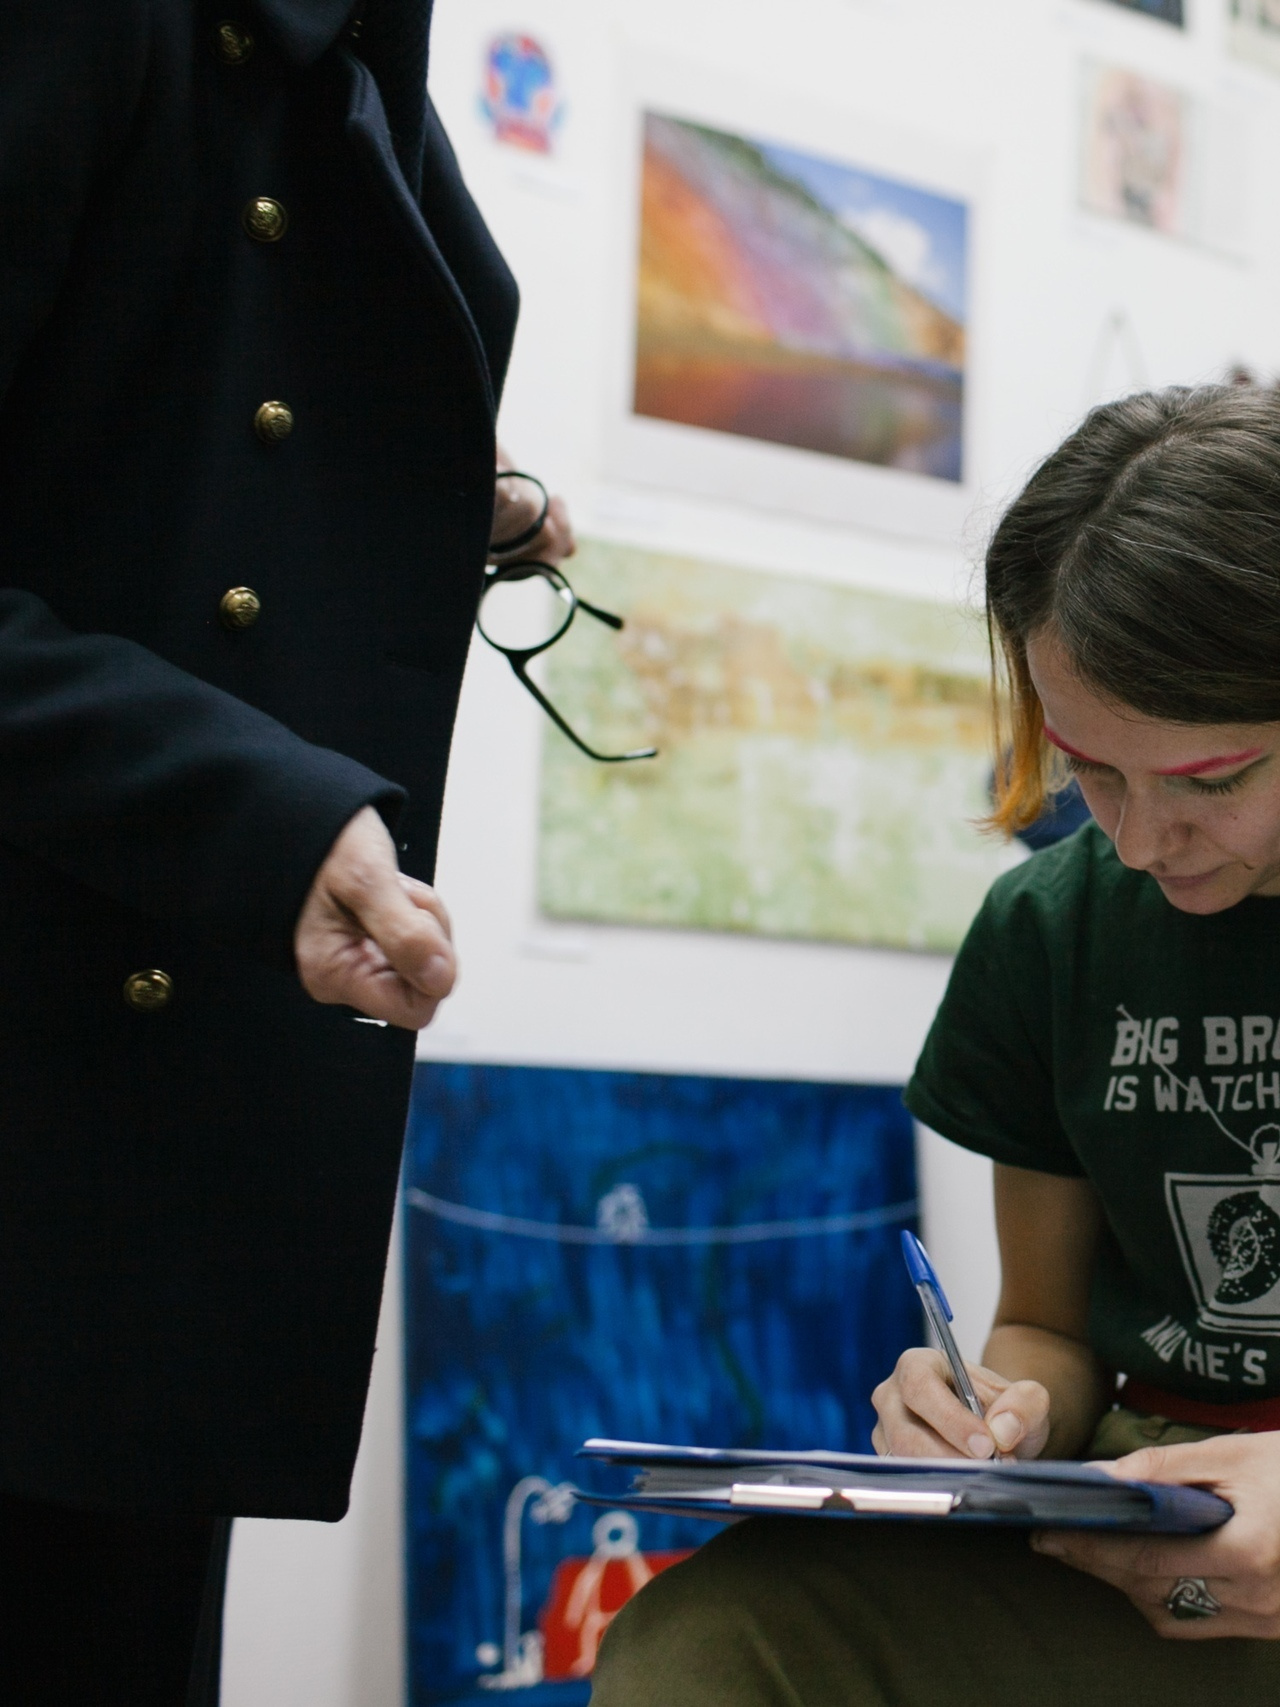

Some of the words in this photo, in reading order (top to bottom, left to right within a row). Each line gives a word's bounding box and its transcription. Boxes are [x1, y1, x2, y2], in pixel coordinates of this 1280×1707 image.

[1111, 1017, 1178, 1066] BIG
[1103, 1075, 1138, 1112] IS
[1142, 1316, 1186, 1361] AND
[1184, 1343, 1268, 1386] HE'S
